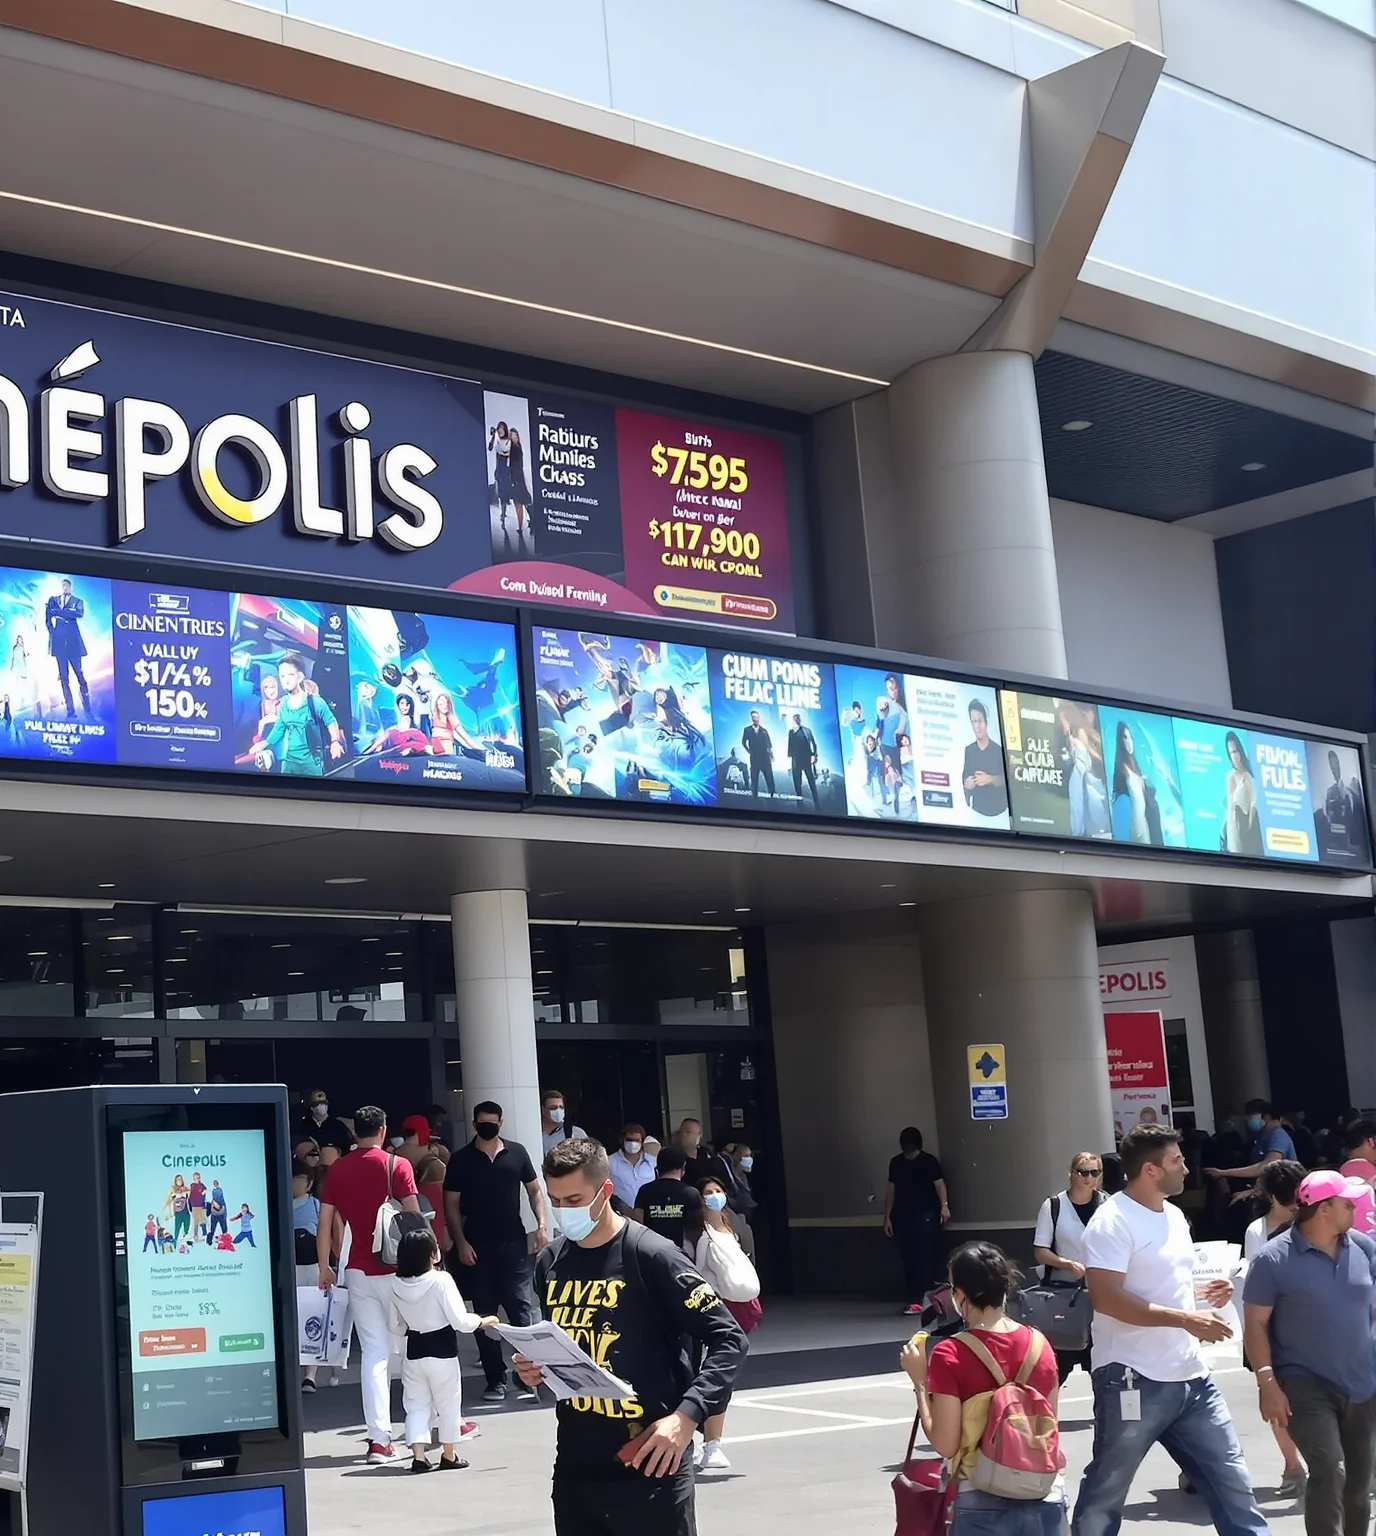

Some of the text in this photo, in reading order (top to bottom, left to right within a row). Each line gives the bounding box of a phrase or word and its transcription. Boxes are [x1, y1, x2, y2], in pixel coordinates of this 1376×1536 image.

[648, 517, 761, 560] $117,900
[661, 552, 689, 568] CAN
[145, 688, 209, 718] 150%
[546, 1280, 626, 1309] LIVES
